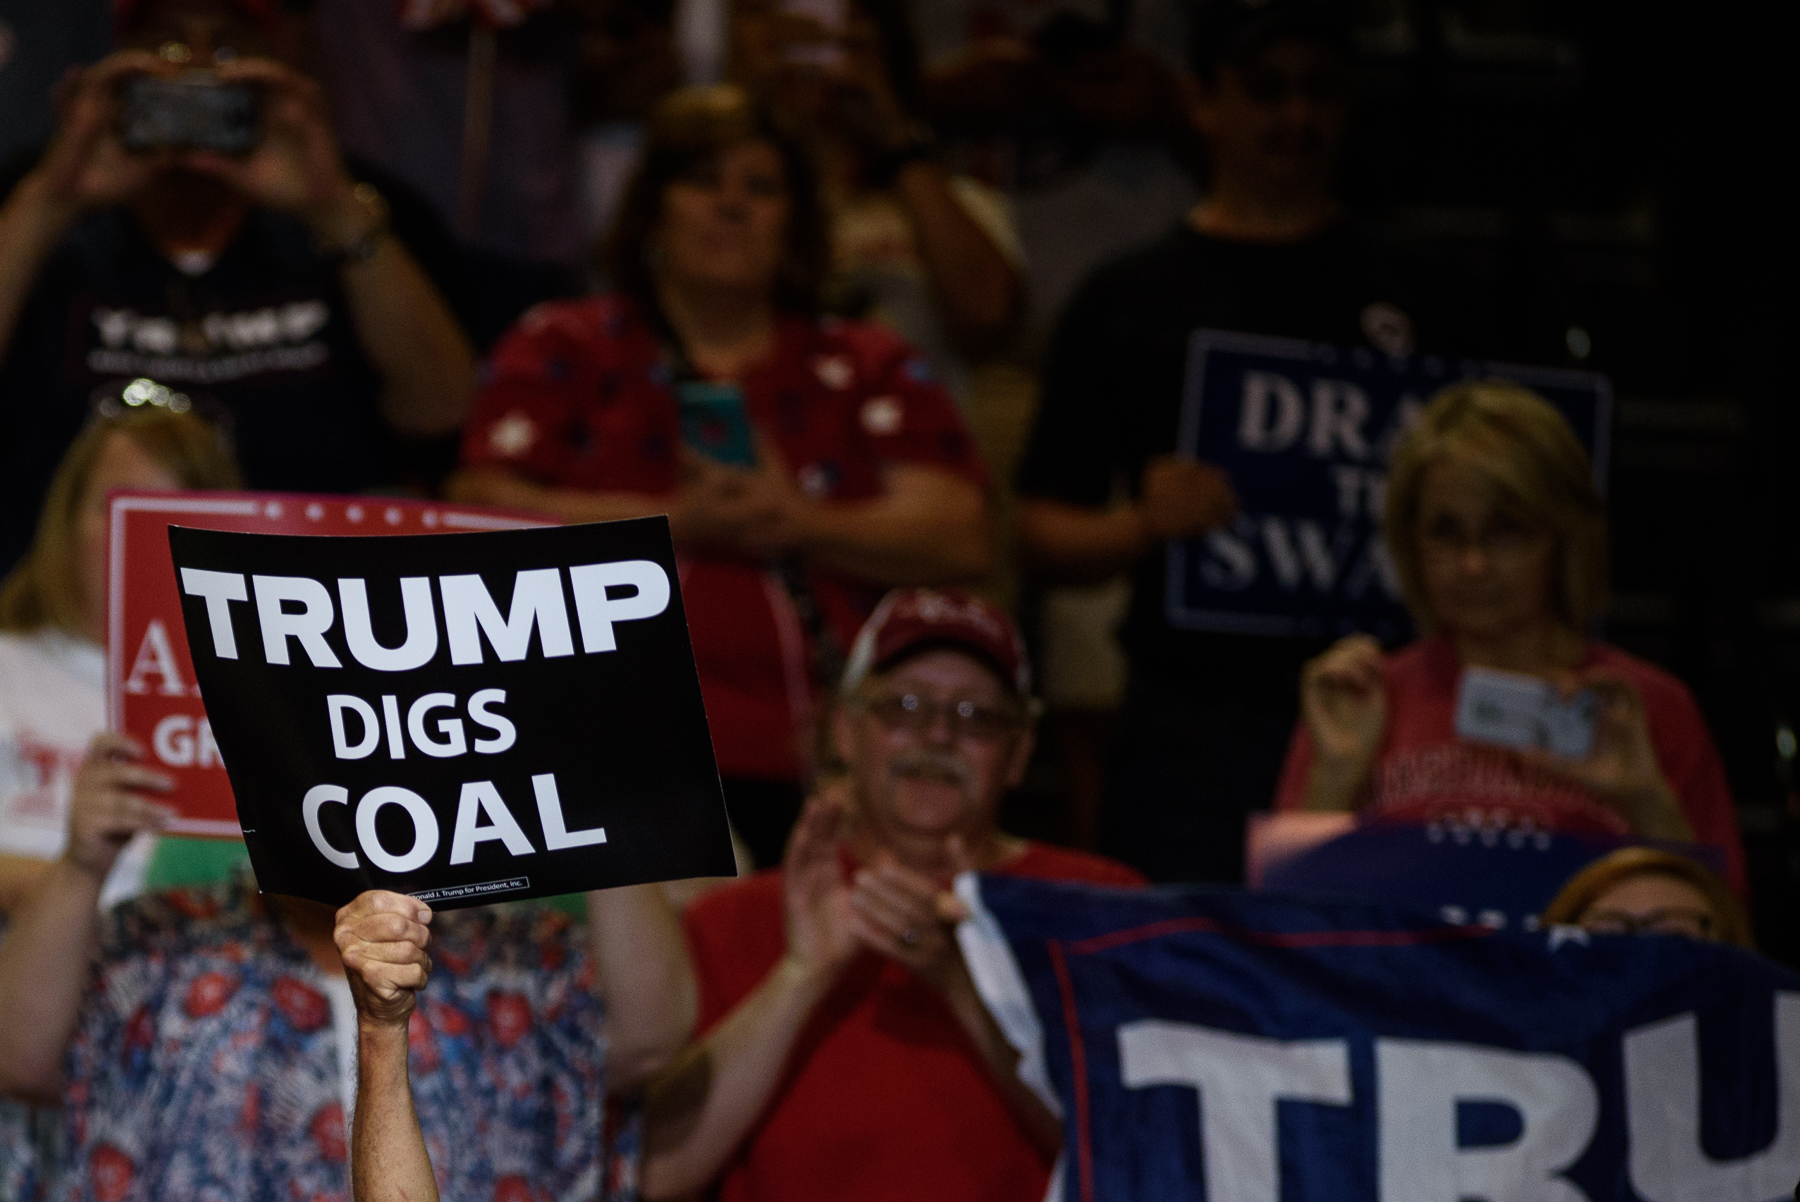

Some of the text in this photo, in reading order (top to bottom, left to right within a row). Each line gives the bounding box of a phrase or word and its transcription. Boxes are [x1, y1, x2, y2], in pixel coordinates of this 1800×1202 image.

[180, 559, 671, 672] TRUMP
[327, 688, 517, 760] DIGS
[302, 773, 607, 873] COAL
[442, 888, 464, 897] Trump
[464, 886, 475, 894] for
